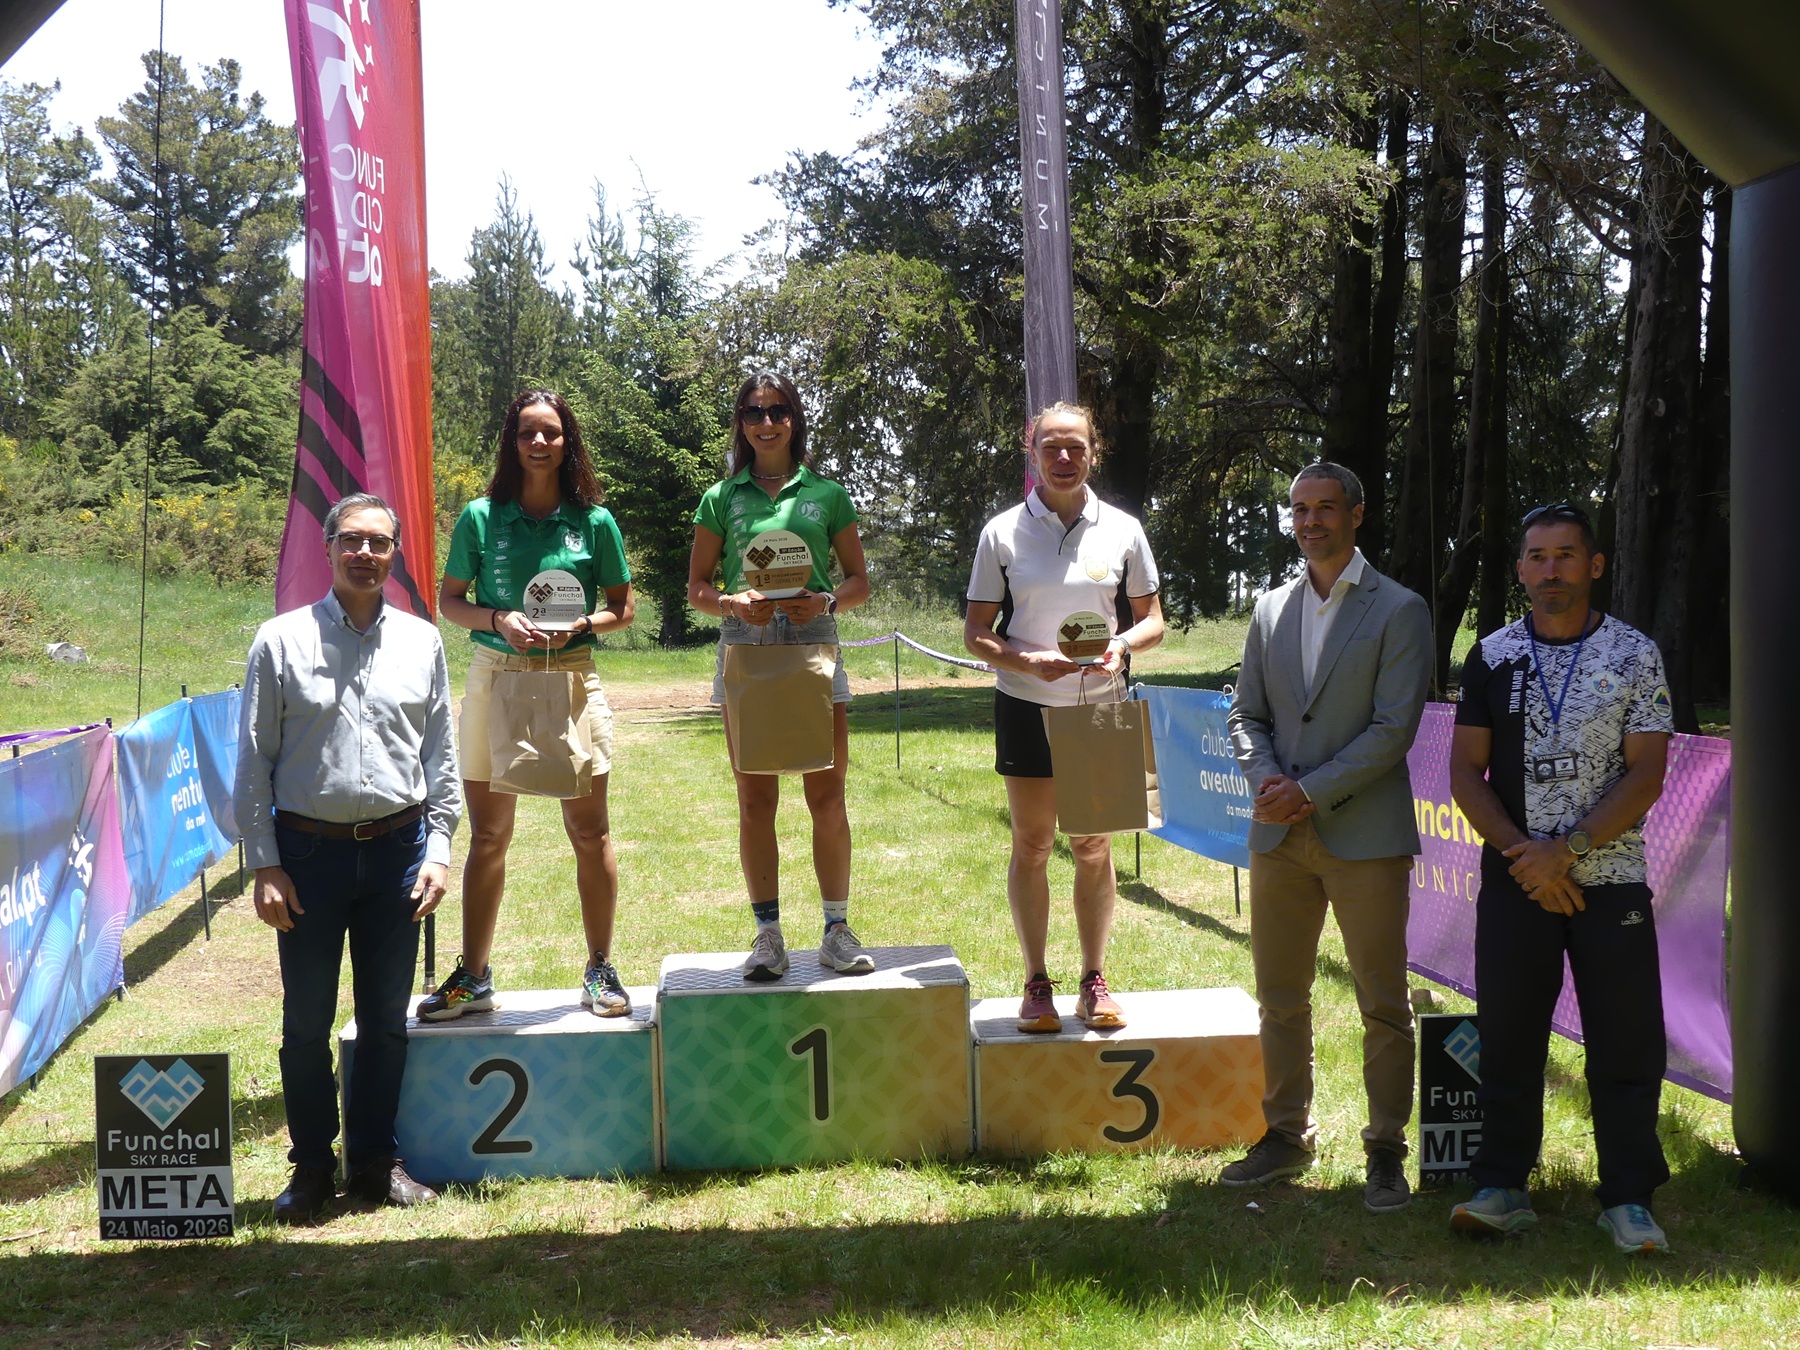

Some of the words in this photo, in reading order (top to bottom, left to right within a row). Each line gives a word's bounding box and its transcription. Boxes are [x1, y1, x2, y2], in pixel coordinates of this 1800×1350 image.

[776, 552, 809, 562] Funchal
[553, 591, 583, 599] Funchal
[532, 607, 547, 619] 2ª
[1511, 669, 1525, 691] HARD
[1508, 691, 1521, 714] TRAIN
[1201, 728, 1235, 760] clube
[791, 1028, 830, 1122] 1
[468, 1057, 533, 1155] 2
[1100, 1049, 1161, 1144] 3
[1452, 1109, 1478, 1121] SKY
[107, 1127, 220, 1152] Funchal
[130, 1154, 158, 1166] SKY
[161, 1153, 197, 1165] RACE
[102, 1174, 230, 1210] META
[105, 1219, 128, 1238] 24
[134, 1219, 178, 1238] Maio
[183, 1217, 229, 1237] 2026
